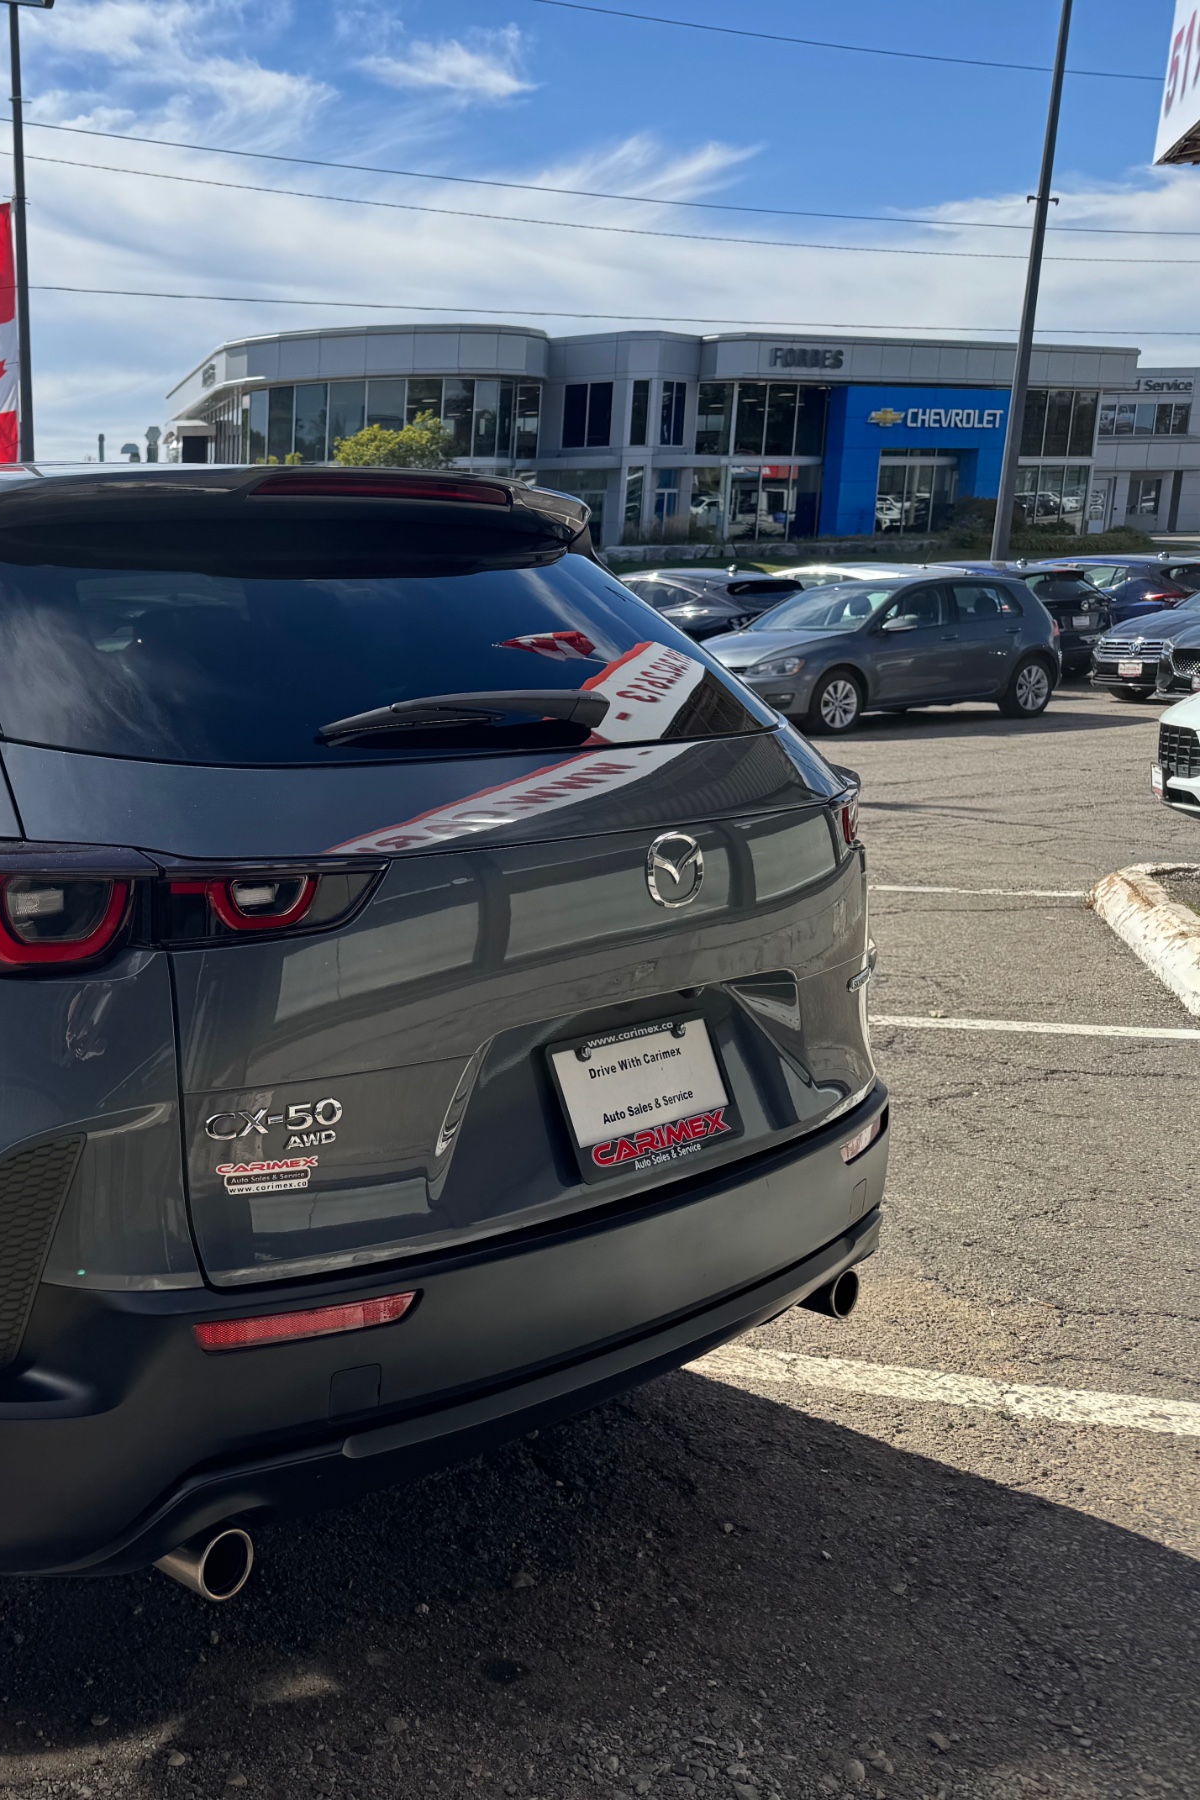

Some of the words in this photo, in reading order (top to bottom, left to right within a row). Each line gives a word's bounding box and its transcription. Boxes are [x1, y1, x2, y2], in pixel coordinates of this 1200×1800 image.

[1144, 379, 1193, 391] Service
[907, 408, 1004, 428] CHEVROLET
[587, 1021, 674, 1048] www.carimex.ca
[588, 1064, 617, 1080] Drive
[617, 1058, 642, 1072] With
[642, 1047, 682, 1065] Carimex
[205, 1097, 343, 1141] CX-50
[602, 1110, 626, 1125] Auto
[626, 1101, 653, 1117] Sales
[654, 1098, 662, 1109] &
[662, 1089, 694, 1106] Service
[284, 1129, 337, 1151] AWD
[592, 1108, 731, 1167] CARIMEX
[216, 1156, 318, 1174] CARIMEX
[634, 1158, 651, 1171] Auto
[651, 1152, 671, 1167] Sales
[671, 1149, 677, 1159] &
[677, 1142, 702, 1157] Service
[229, 1181, 307, 1194] www.carimex.ca
[231, 1177, 249, 1185] Auto
[250, 1174, 270, 1183] Sales
[279, 1172, 305, 1180] Service
